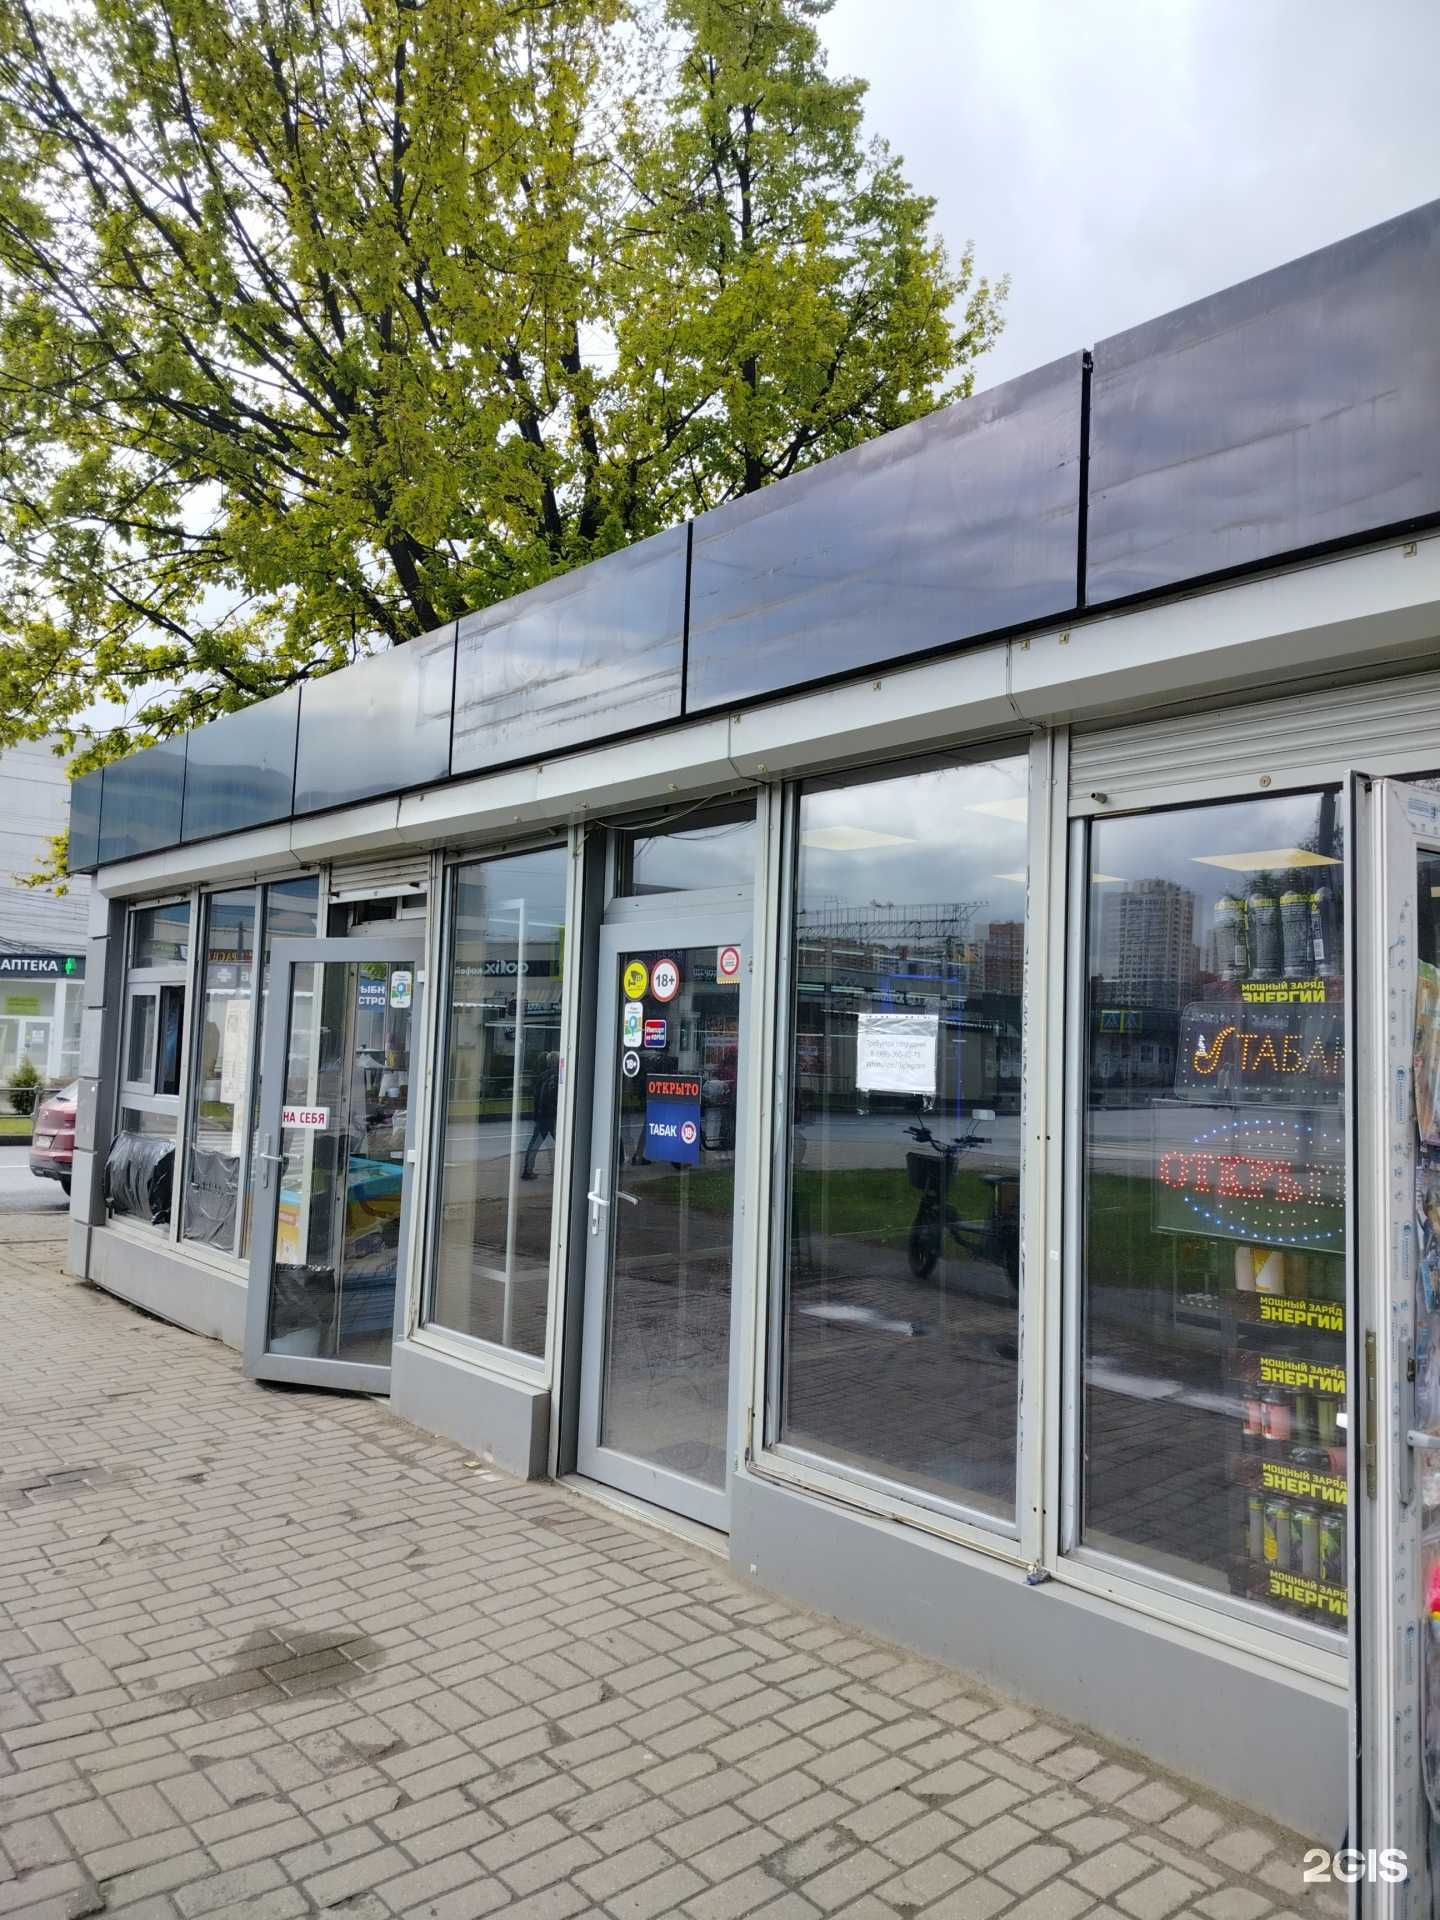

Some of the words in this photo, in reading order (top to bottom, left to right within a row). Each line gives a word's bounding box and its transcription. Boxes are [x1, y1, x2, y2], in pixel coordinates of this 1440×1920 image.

[0, 959, 58, 971] АПТЕКА
[655, 974, 675, 988] 18+
[1242, 982, 1288, 991] МОЩНЫЙ
[1291, 981, 1325, 990] ЗАРЯД
[1242, 991, 1326, 1003] ЭНЕРГИИ
[648, 1081, 699, 1096] ОТКРЫТО
[283, 1111, 296, 1123] НА
[299, 1112, 325, 1124] СЕБЯ
[649, 1123, 677, 1137] ТАБАК
[1260, 1297, 1306, 1310] МОЩНЫЙ
[1309, 1303, 1343, 1317] ЗАРЯД
[1261, 1306, 1344, 1331] ЭНЕРГИИ
[1260, 1358, 1308, 1372] МОЩНЫЙ
[1311, 1366, 1345, 1379] ЗАРЯД
[1261, 1366, 1346, 1394] ЭНЕРГИИ
[1263, 1463, 1310, 1481] МОЩНЫЙ
[1312, 1474, 1348, 1490] ЗАРЯД
[1263, 1473, 1348, 1505] ЭНЕРГИИ
[1270, 1570, 1317, 1590] МОЩНЫЙ
[1319, 1584, 1348, 1601] ЗАРЯ
